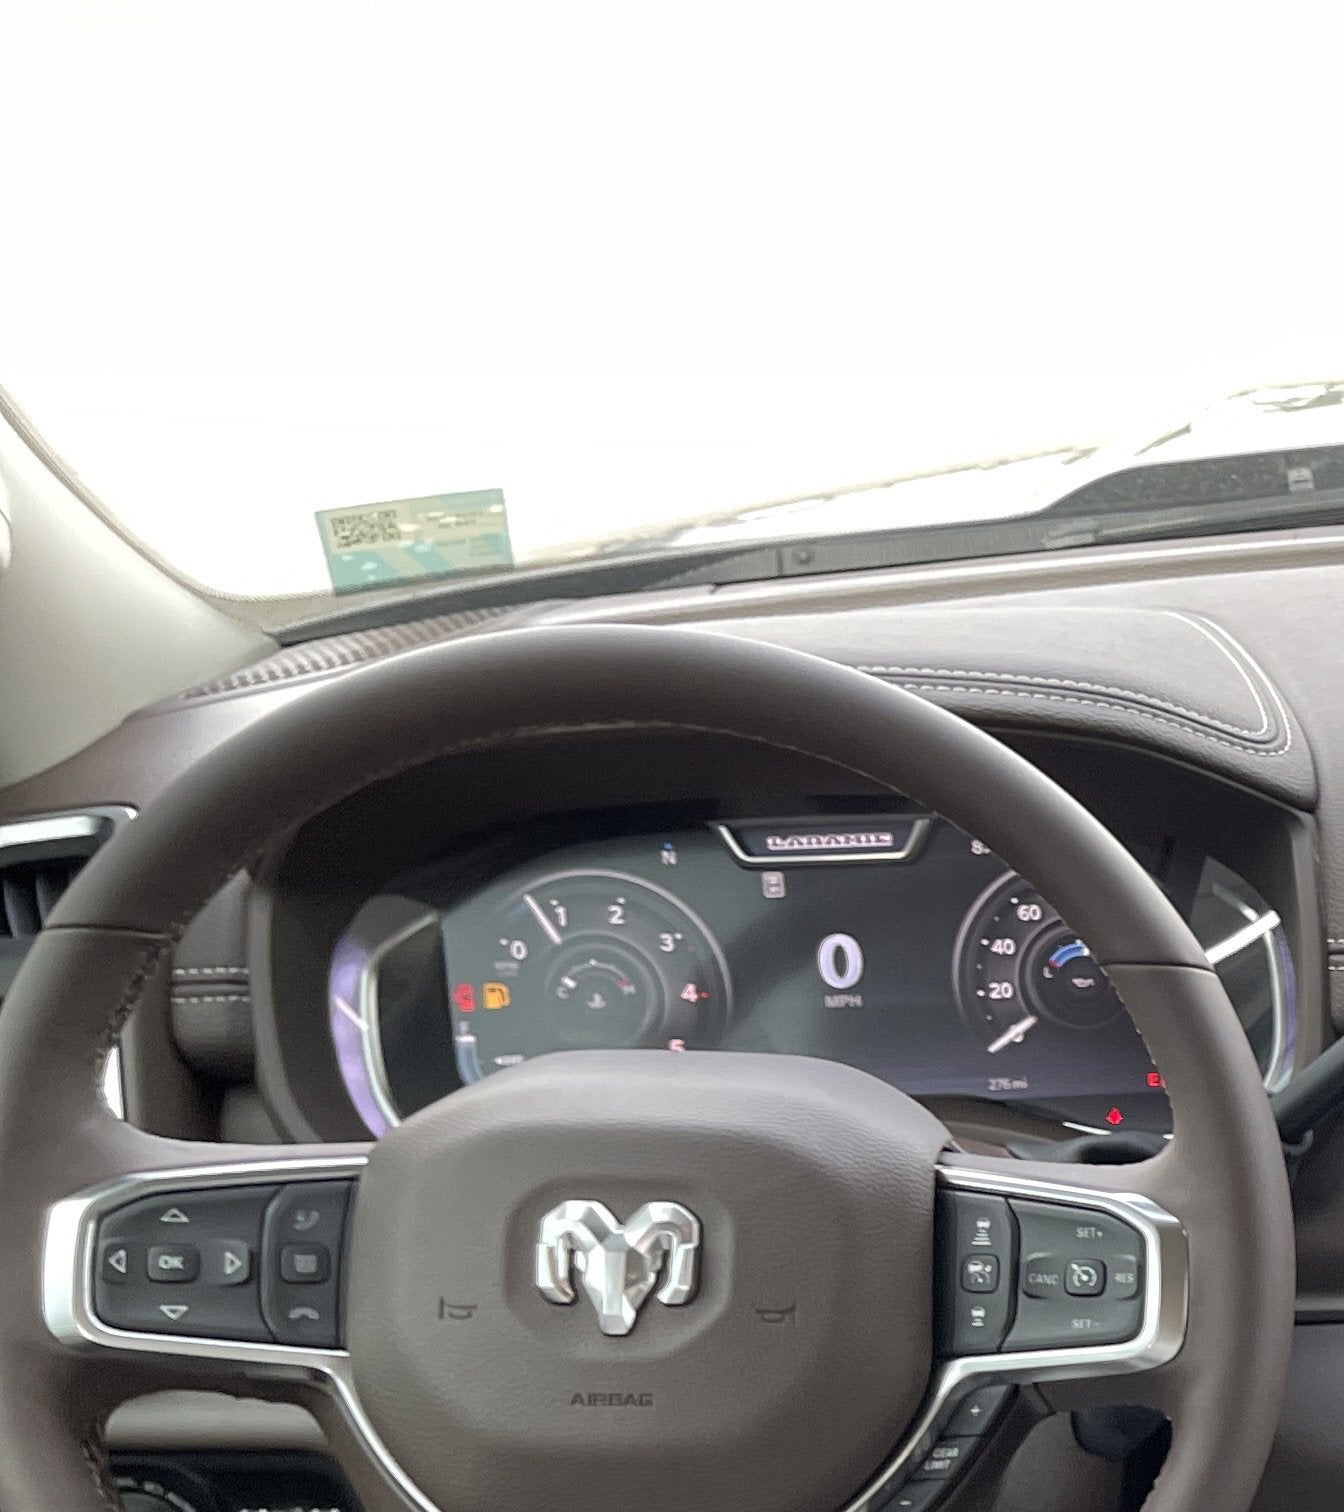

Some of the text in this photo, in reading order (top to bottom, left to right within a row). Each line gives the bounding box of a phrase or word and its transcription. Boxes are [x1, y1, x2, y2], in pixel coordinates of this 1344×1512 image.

[554, 906, 568, 927] 1
[608, 905, 626, 925] 2
[1016, 904, 1042, 921] 60
[509, 940, 528, 960] 0
[659, 932, 676, 952] 3
[990, 938, 1016, 956] 40
[816, 932, 865, 990] 0
[680, 983, 699, 1003] 4
[988, 982, 1014, 1000] 20
[824, 994, 864, 1009] MPH
[157, 1255, 185, 1270] OK
[1028, 1271, 1060, 1286] CANC
[570, 1392, 654, 1408] AIRBAG
